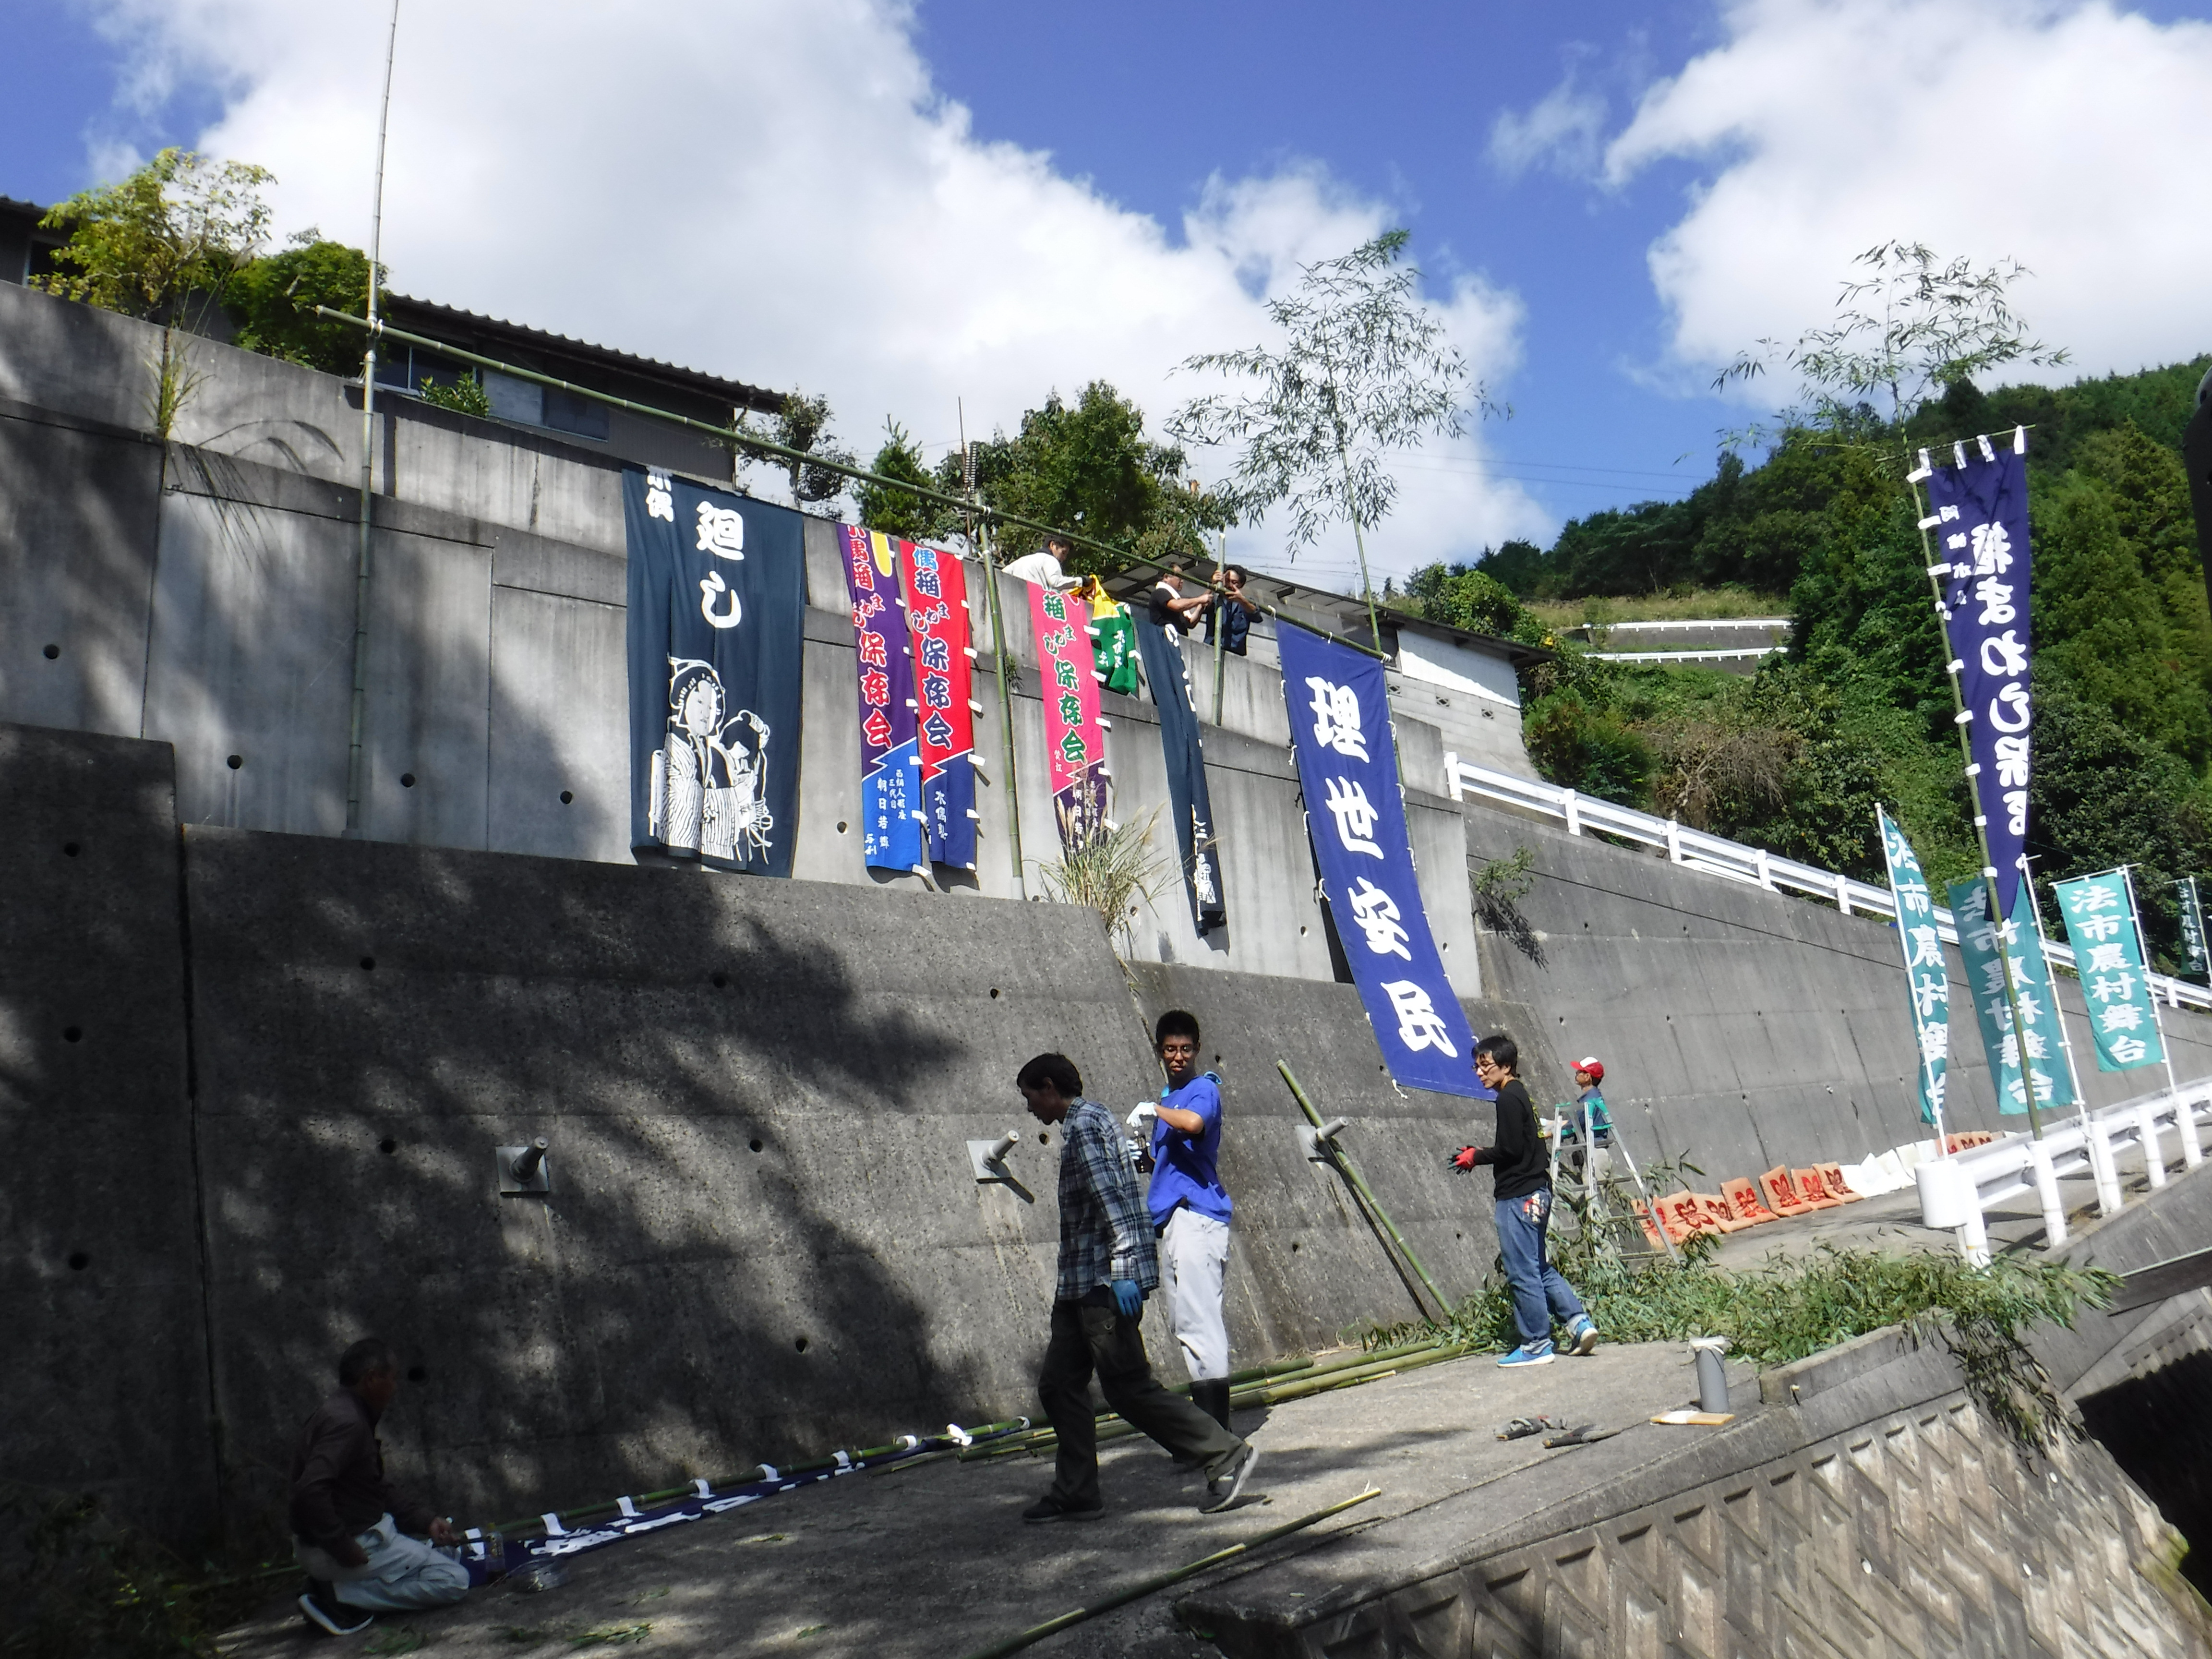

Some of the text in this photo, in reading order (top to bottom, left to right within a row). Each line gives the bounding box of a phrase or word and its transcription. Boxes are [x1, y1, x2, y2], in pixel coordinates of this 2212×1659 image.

[696, 501, 745, 628] 廻し
[1042, 587, 1088, 765] 箱まわし保存会
[1305, 676, 1458, 1058] 理世安民
[2070, 885, 2146, 1064] 法市農村舞台
